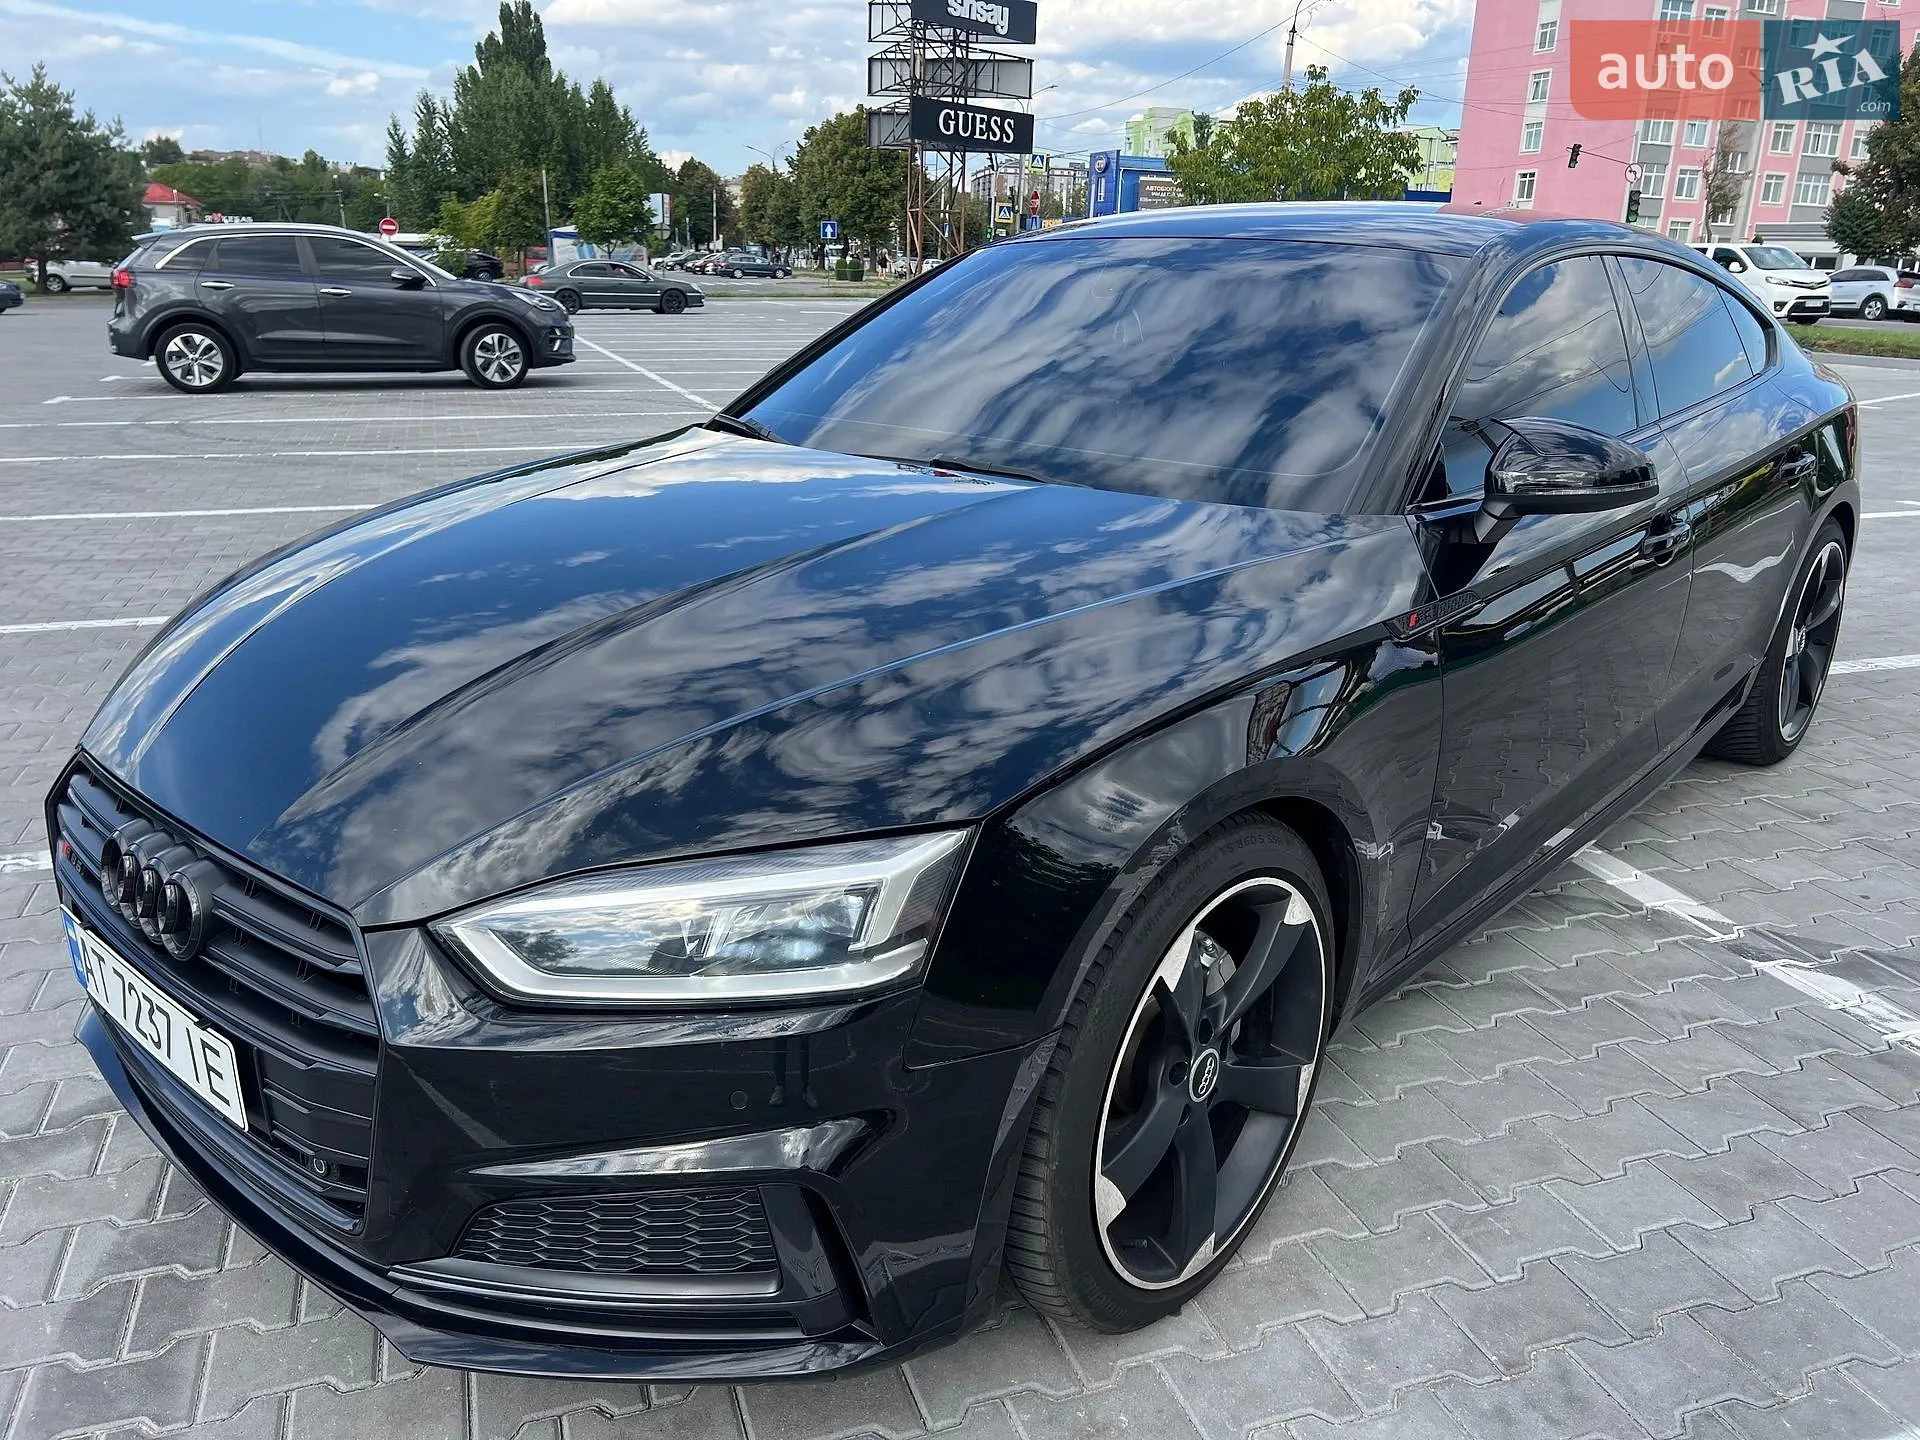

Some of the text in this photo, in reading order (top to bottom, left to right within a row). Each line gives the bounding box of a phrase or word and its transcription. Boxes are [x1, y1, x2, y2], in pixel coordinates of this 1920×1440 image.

[938, 108, 1015, 144] GUESS
[80, 936, 232, 1108] AT 7237 IE
